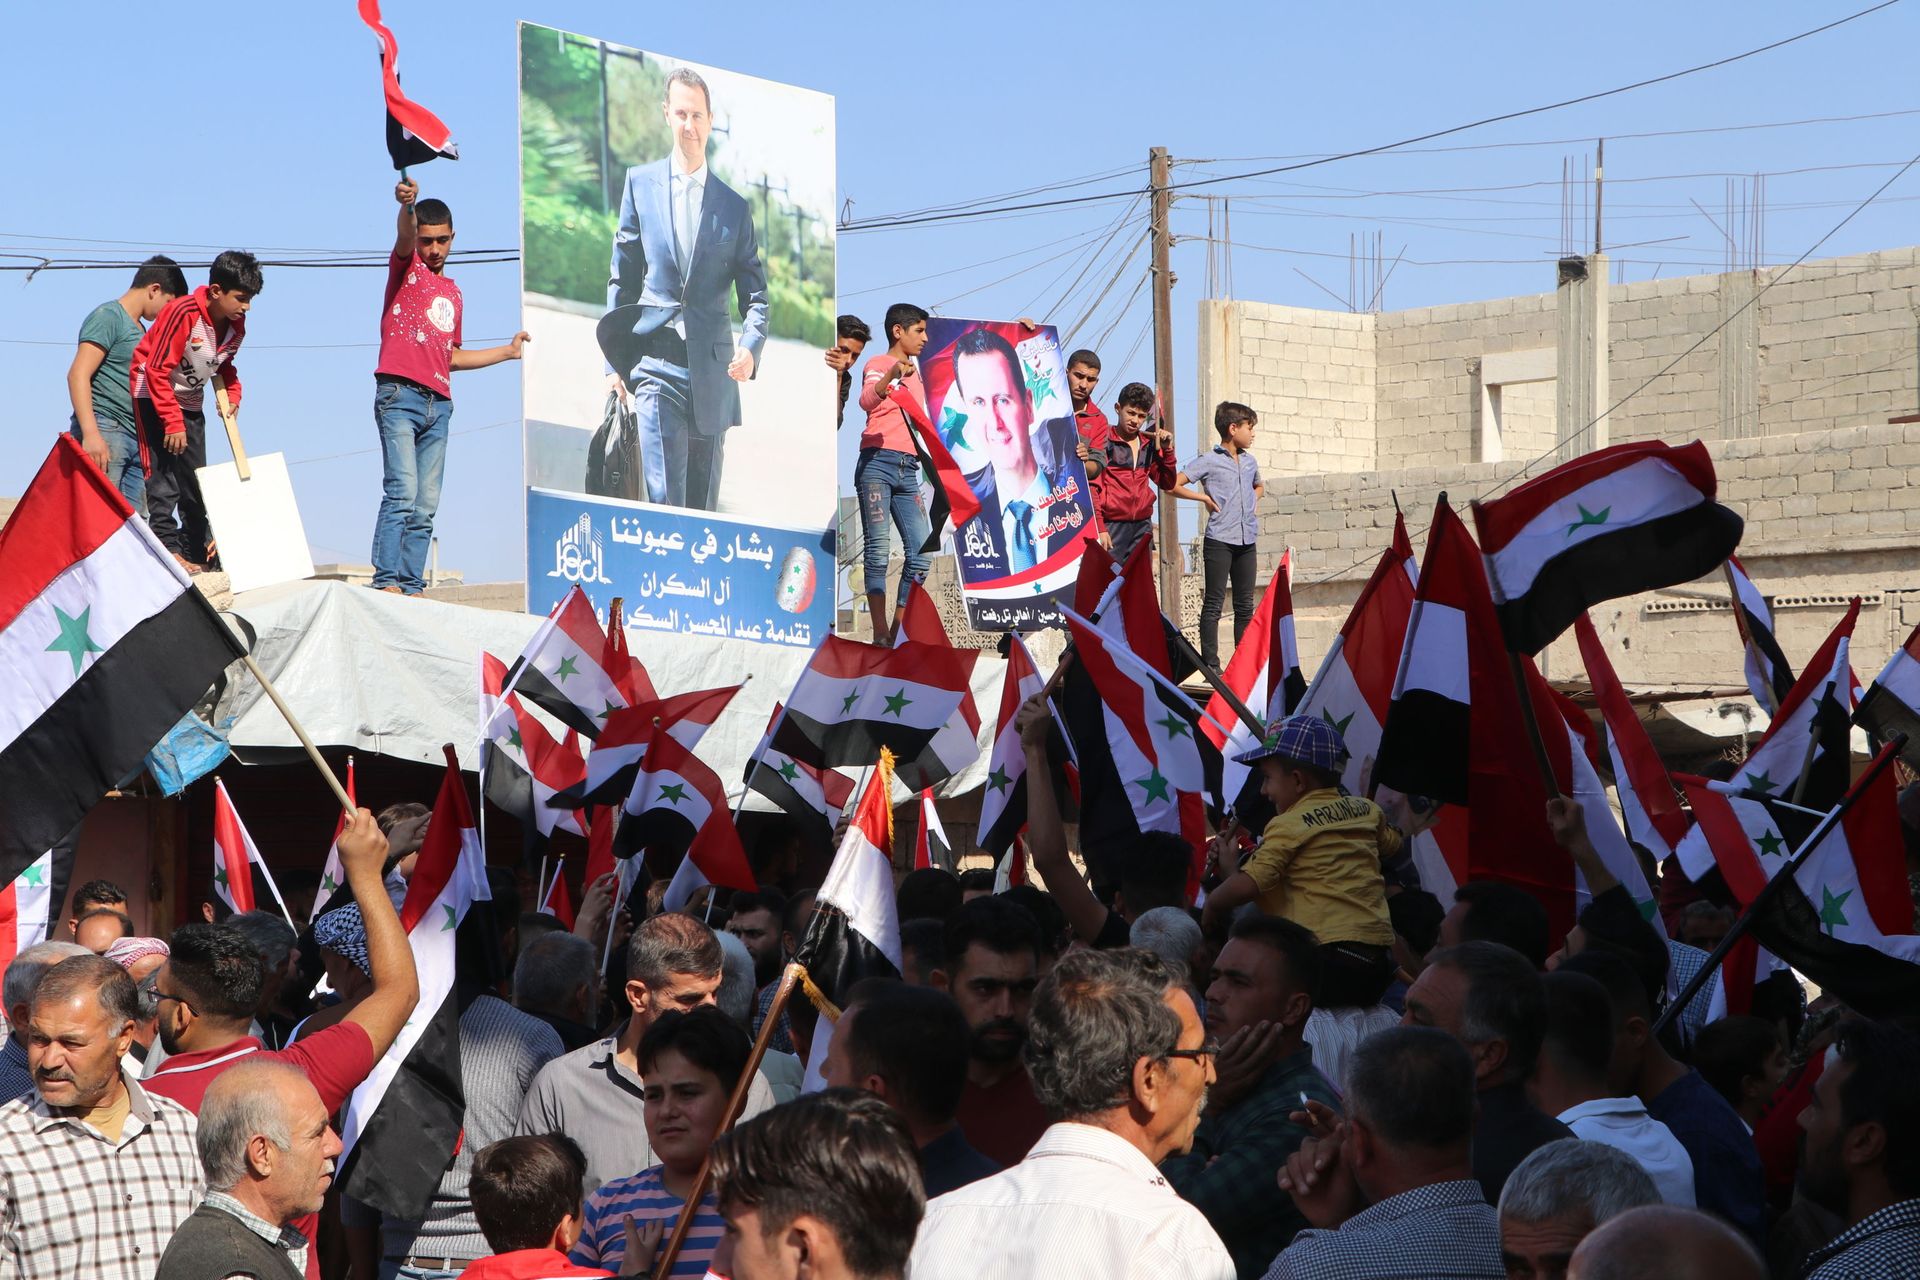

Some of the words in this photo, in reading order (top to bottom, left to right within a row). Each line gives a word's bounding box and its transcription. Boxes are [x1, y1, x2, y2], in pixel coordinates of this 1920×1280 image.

[610, 516, 685, 556] عيوننا
[690, 527, 718, 564] في
[719, 531, 774, 570] بشار
[640, 571, 710, 599] السكران
[713, 576, 731, 606] آل
[608, 604, 679, 631] السكر
[682, 613, 731, 636] المحسن
[981, 608, 1001, 624] رفعت
[1001, 608, 1012, 623] تل
[1012, 606, 1030, 626] أهالي
[1038, 608, 1057, 624] حسين
[734, 619, 762, 640] عبد
[765, 617, 811, 646] تقدمة
